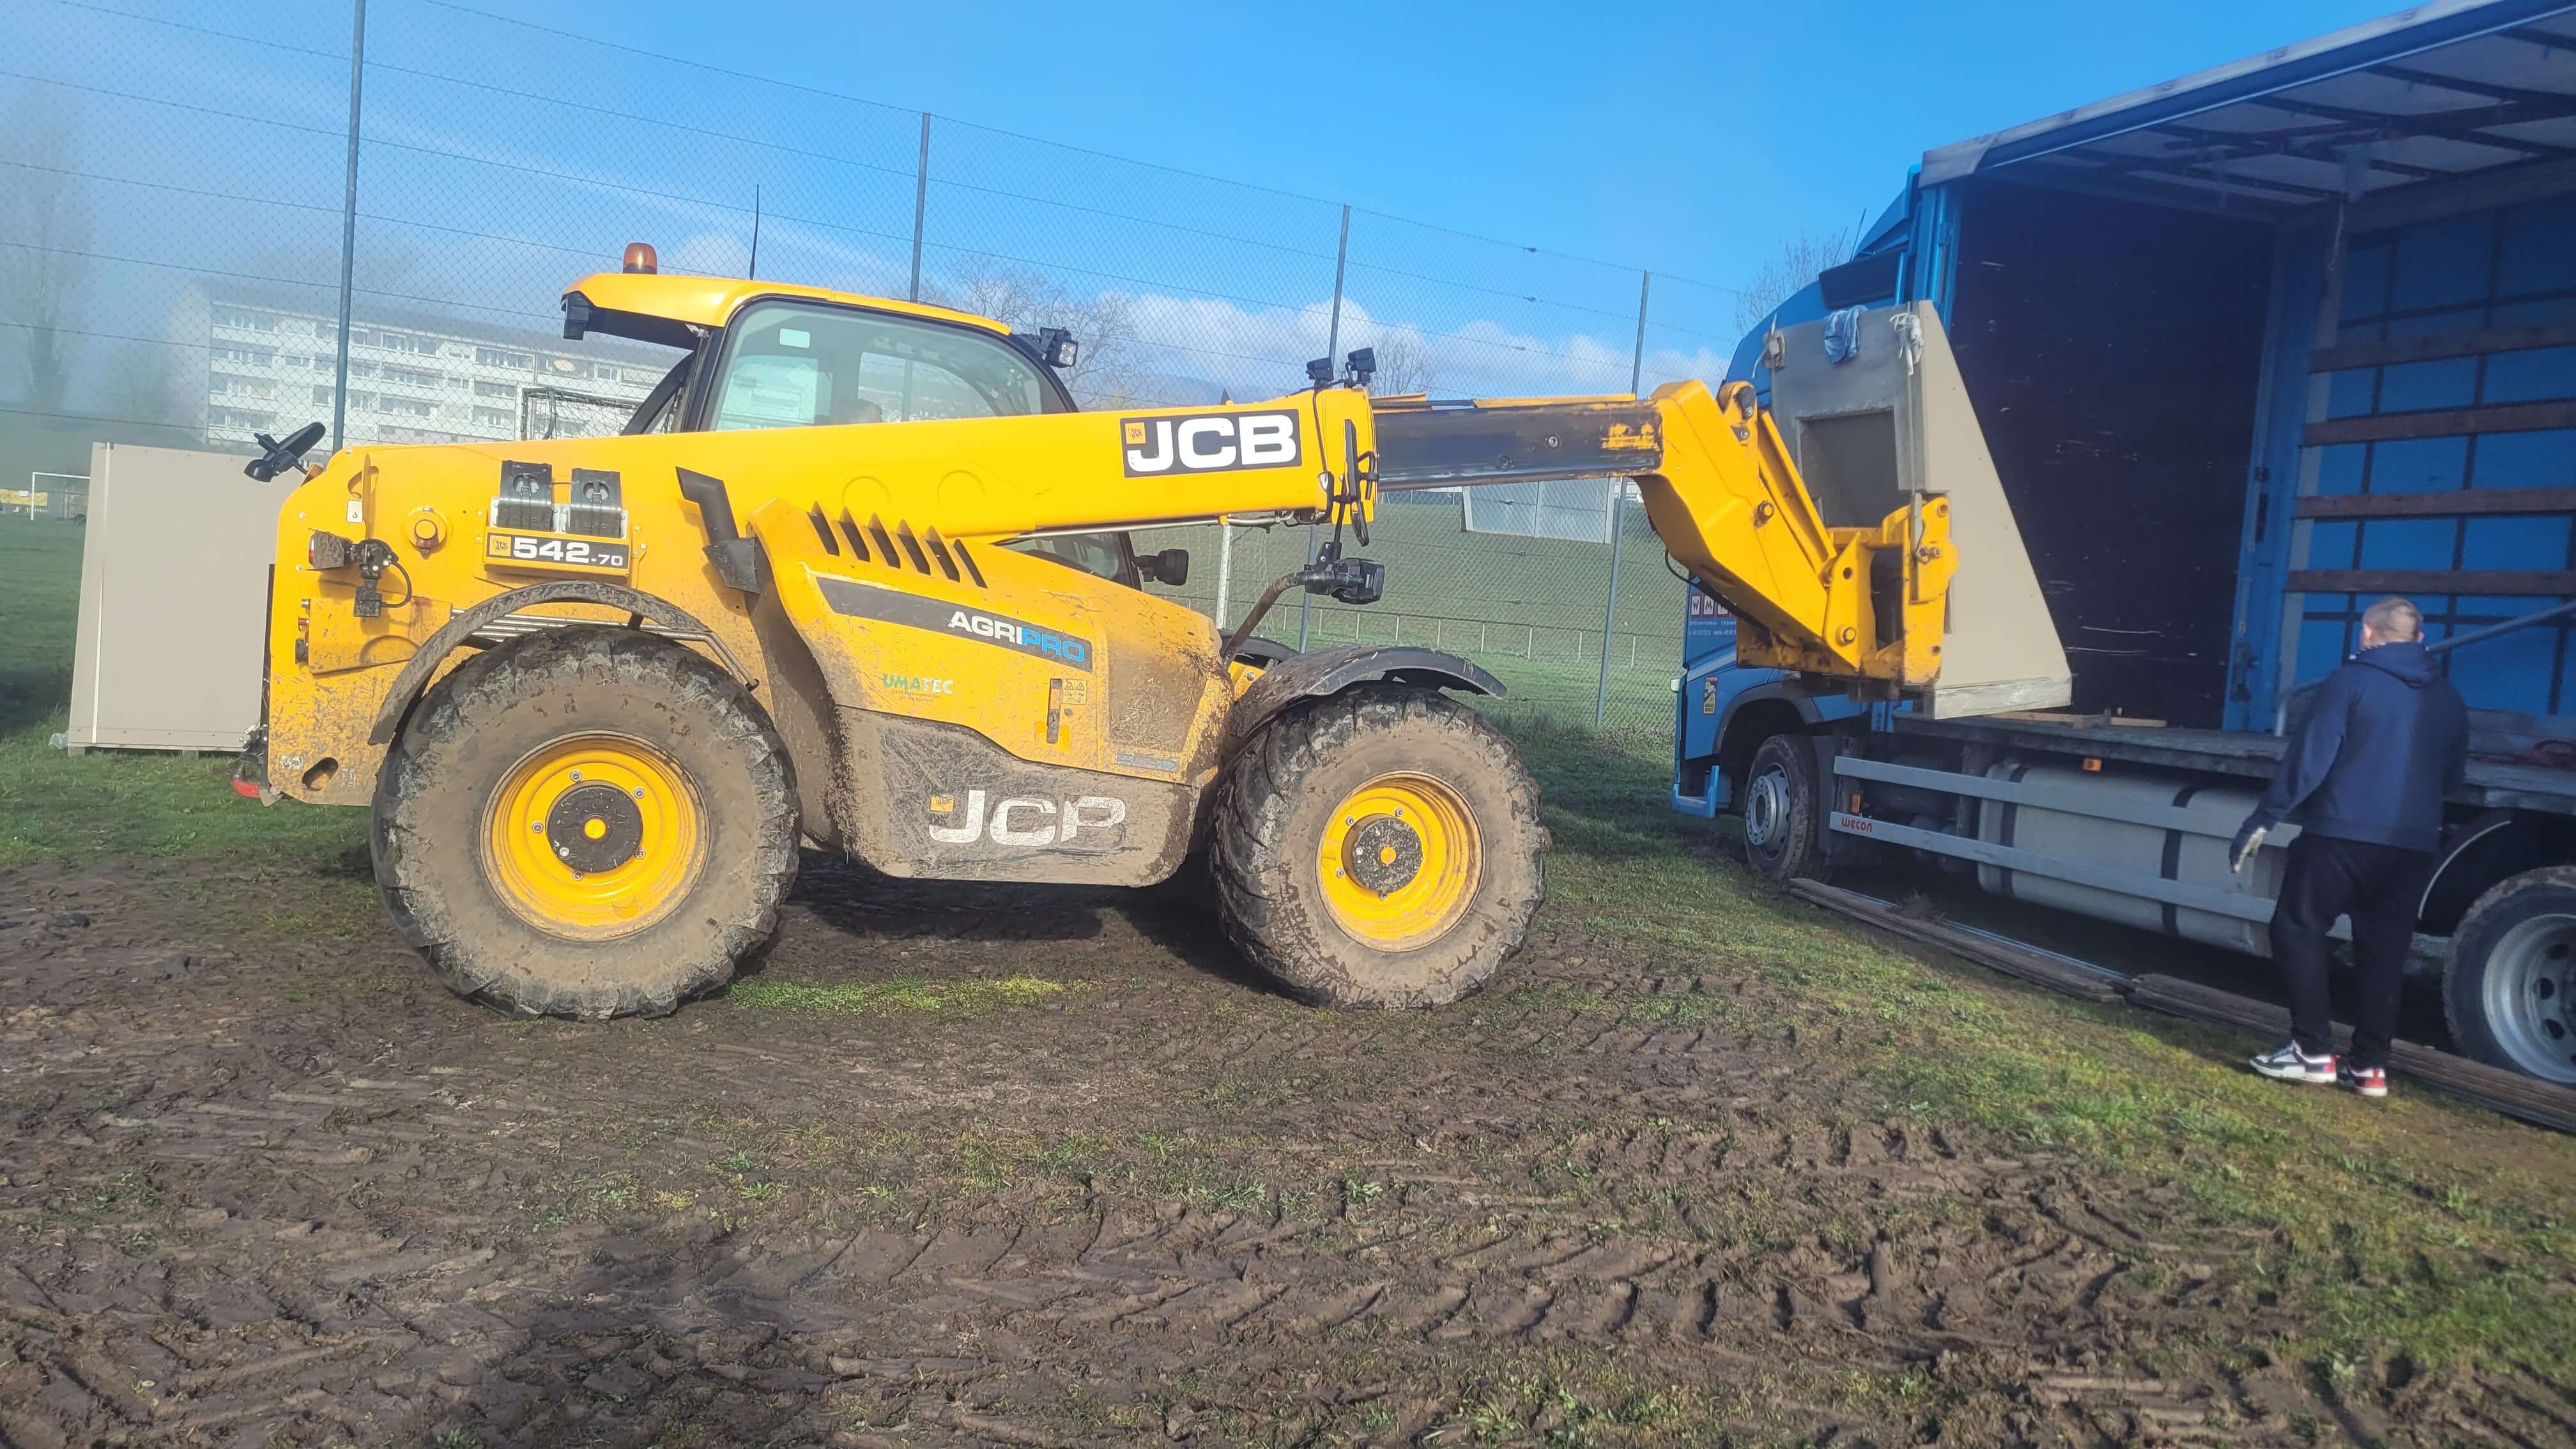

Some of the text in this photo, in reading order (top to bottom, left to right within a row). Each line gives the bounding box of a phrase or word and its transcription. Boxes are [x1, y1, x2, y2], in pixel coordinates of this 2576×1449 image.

[1128, 415, 1296, 471] JCB
[513, 537, 623, 567] 542-70
[947, 611, 1085, 663] AGRIPRO
[883, 674, 953, 695] UMATEC
[1841, 817, 1872, 832] wecon
